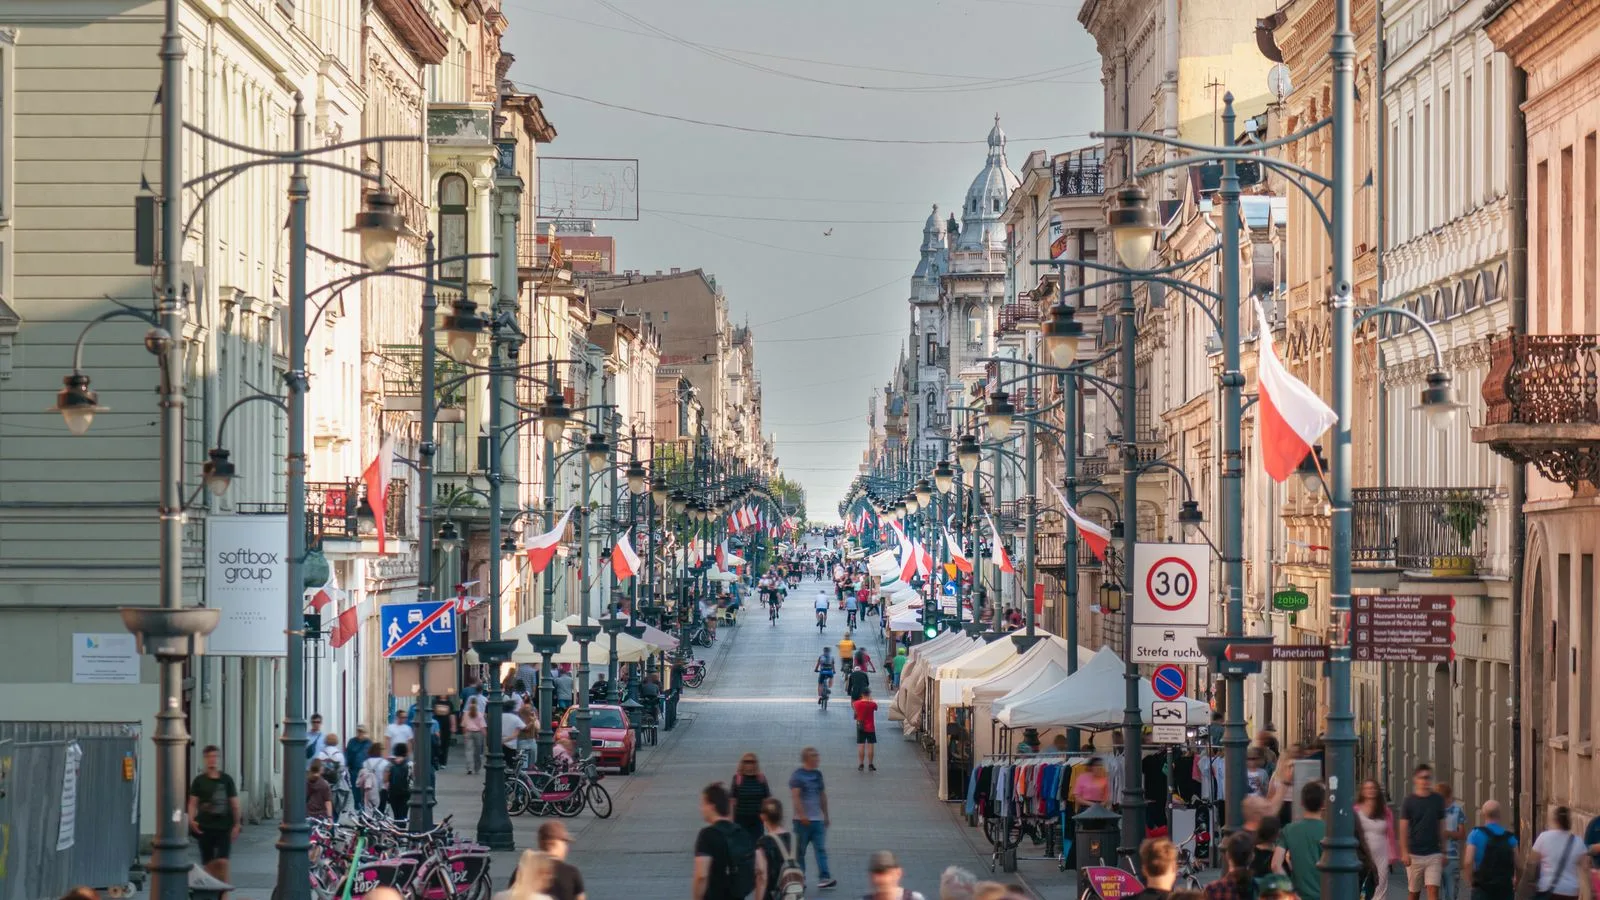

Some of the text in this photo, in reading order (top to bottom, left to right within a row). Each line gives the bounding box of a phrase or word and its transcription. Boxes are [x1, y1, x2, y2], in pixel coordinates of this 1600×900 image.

[218, 548, 278, 564] softbox
[224, 567, 272, 584] group
[1155, 571, 1189, 597] 30
[1137, 646, 1169, 657] Strefa
[1272, 648, 1325, 658] Planetarium
